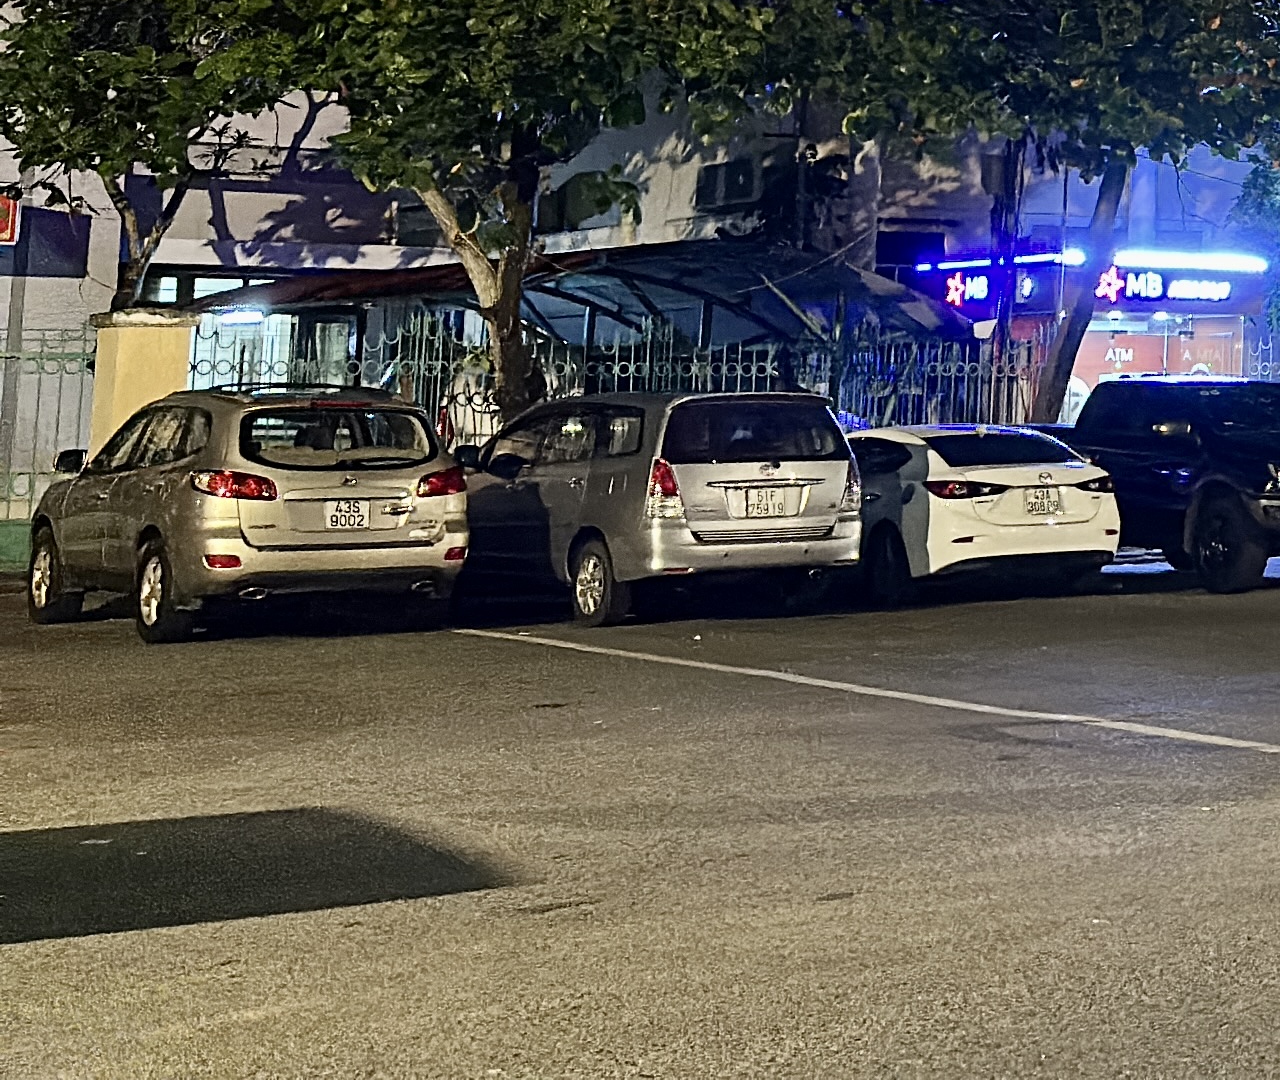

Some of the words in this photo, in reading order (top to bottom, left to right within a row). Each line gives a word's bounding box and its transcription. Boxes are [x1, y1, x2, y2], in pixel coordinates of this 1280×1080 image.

[1125, 271, 1163, 298] MB
[1105, 347, 1133, 362] ATM
[335, 500, 360, 513] 43S
[330, 514, 364, 527] 9002
